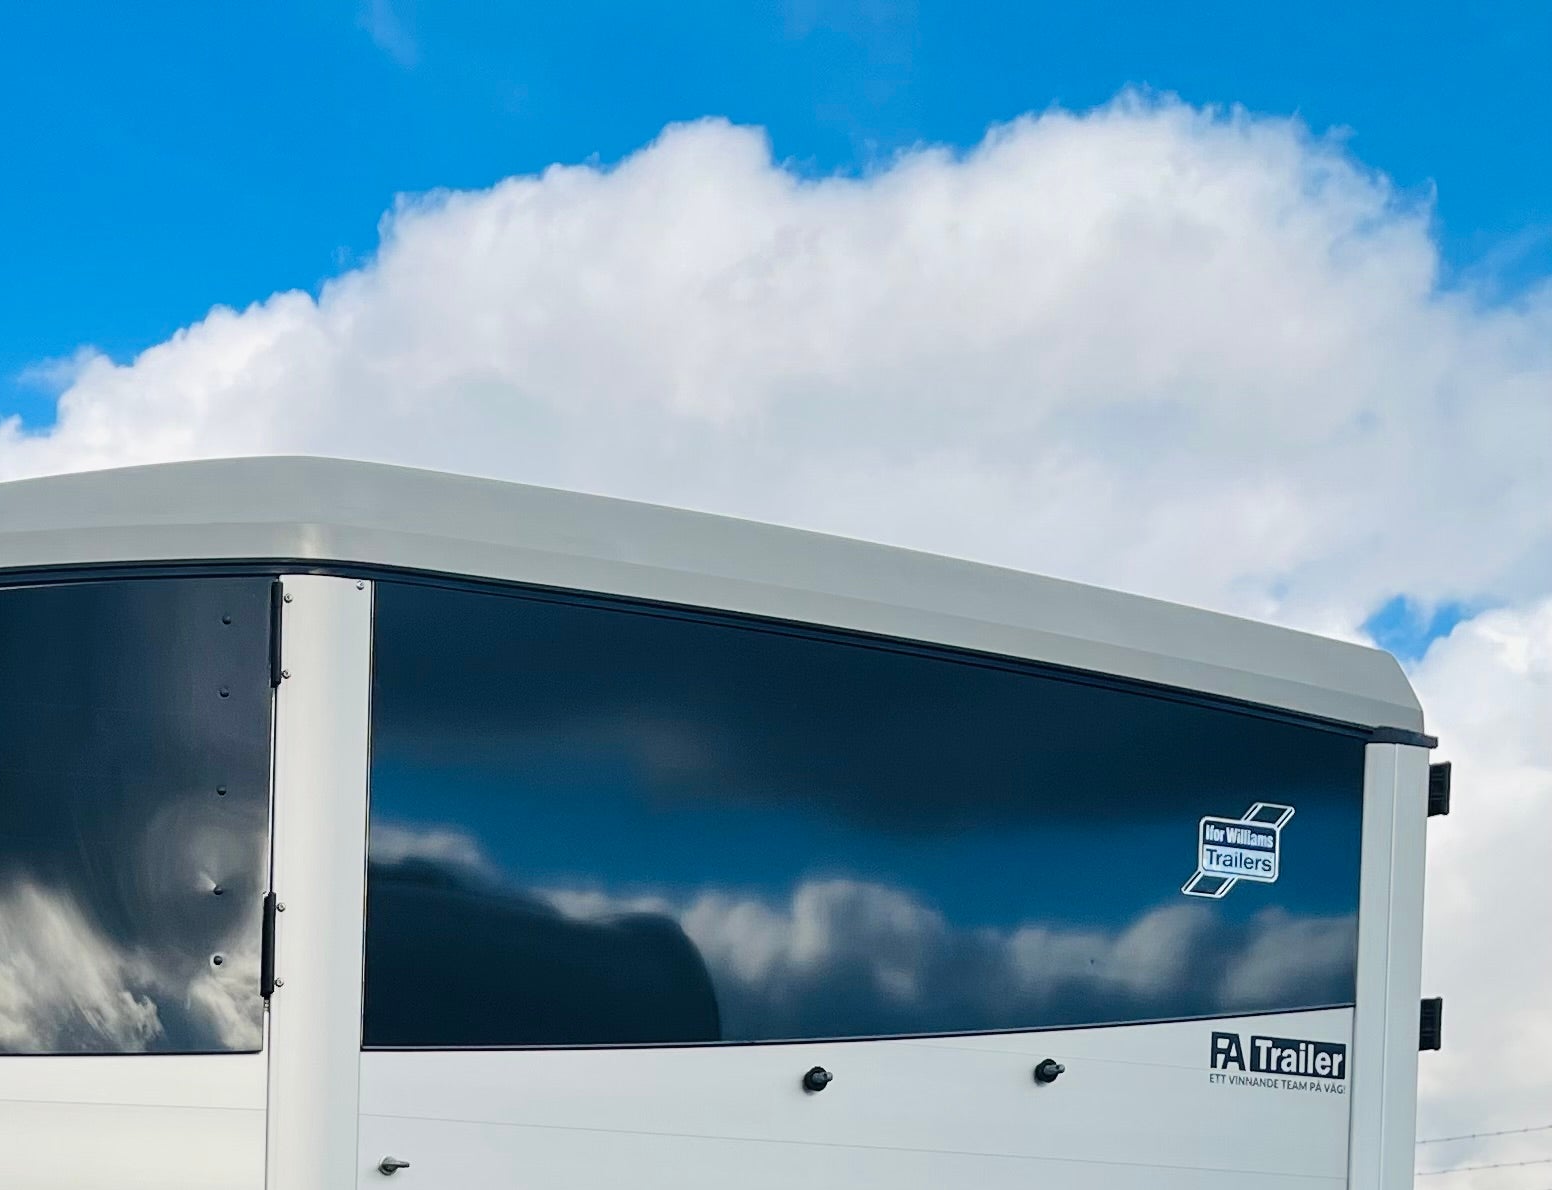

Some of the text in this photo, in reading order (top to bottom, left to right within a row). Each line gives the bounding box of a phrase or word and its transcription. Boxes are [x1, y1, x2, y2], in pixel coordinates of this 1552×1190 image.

[1205, 823, 1274, 848] Ifor Williams
[1205, 848, 1272, 872] Trailers
[1210, 1031, 1343, 1077] FA Trailer
[1209, 1073, 1227, 1084] ETT
[1228, 1075, 1279, 1089] VINNANDE
[1281, 1079, 1308, 1091] TEAM
